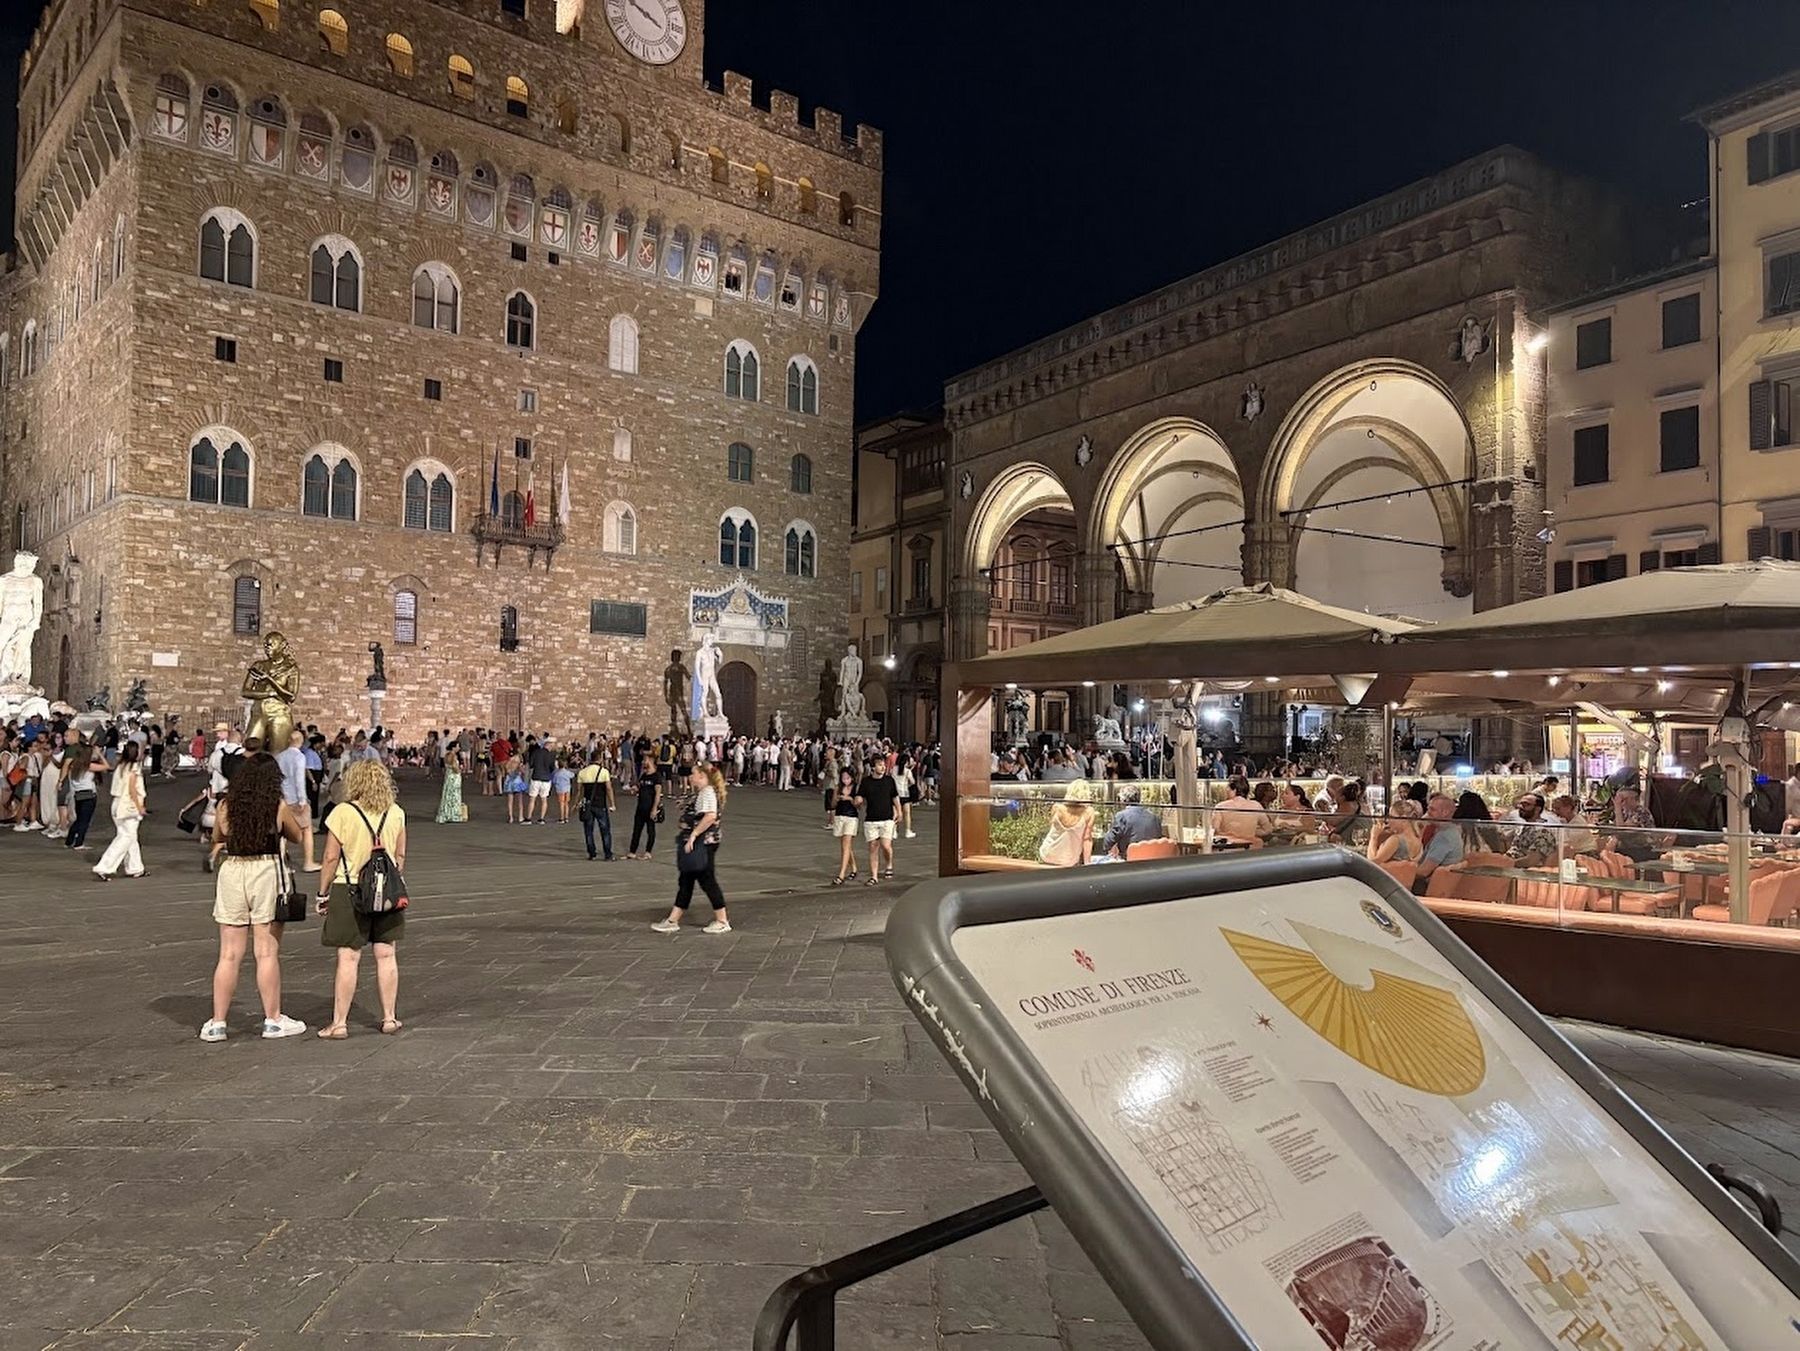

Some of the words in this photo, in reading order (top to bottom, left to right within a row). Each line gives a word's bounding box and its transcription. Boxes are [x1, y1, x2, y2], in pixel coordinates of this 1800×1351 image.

[1019, 985, 1100, 1017] COMUNE
[1100, 981, 1124, 1000] DI
[1123, 968, 1191, 994] FIRENZE
[1034, 1010, 1098, 1031] SOPRINTENDENZA
